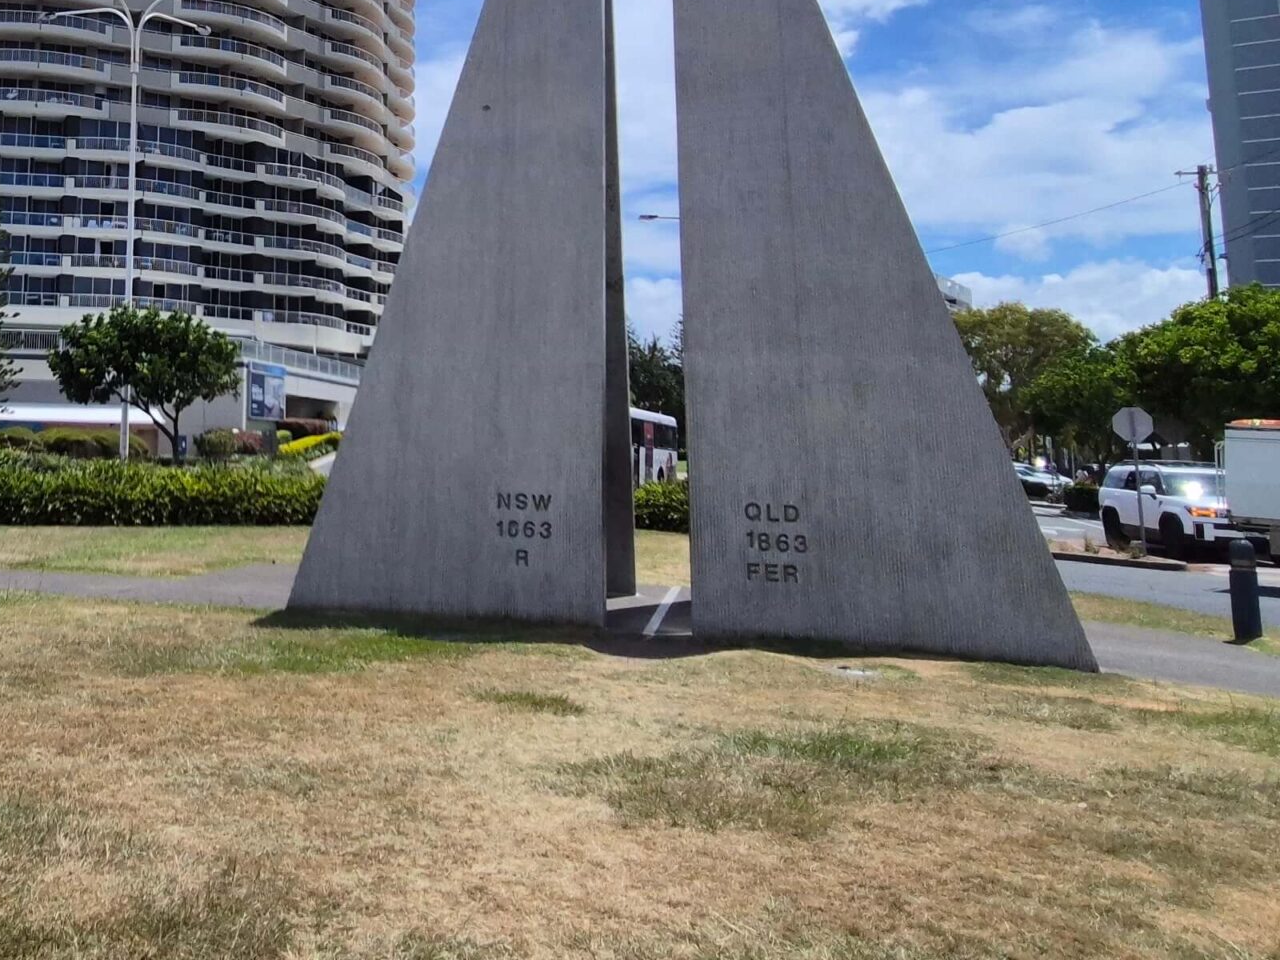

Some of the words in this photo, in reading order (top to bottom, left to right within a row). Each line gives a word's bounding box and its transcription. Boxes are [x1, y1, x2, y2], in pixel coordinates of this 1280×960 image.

[497, 492, 552, 512] NSW
[744, 502, 800, 523] QLD
[746, 529, 808, 553] 1863
[515, 548, 529, 567] R
[746, 562, 799, 584] FER
